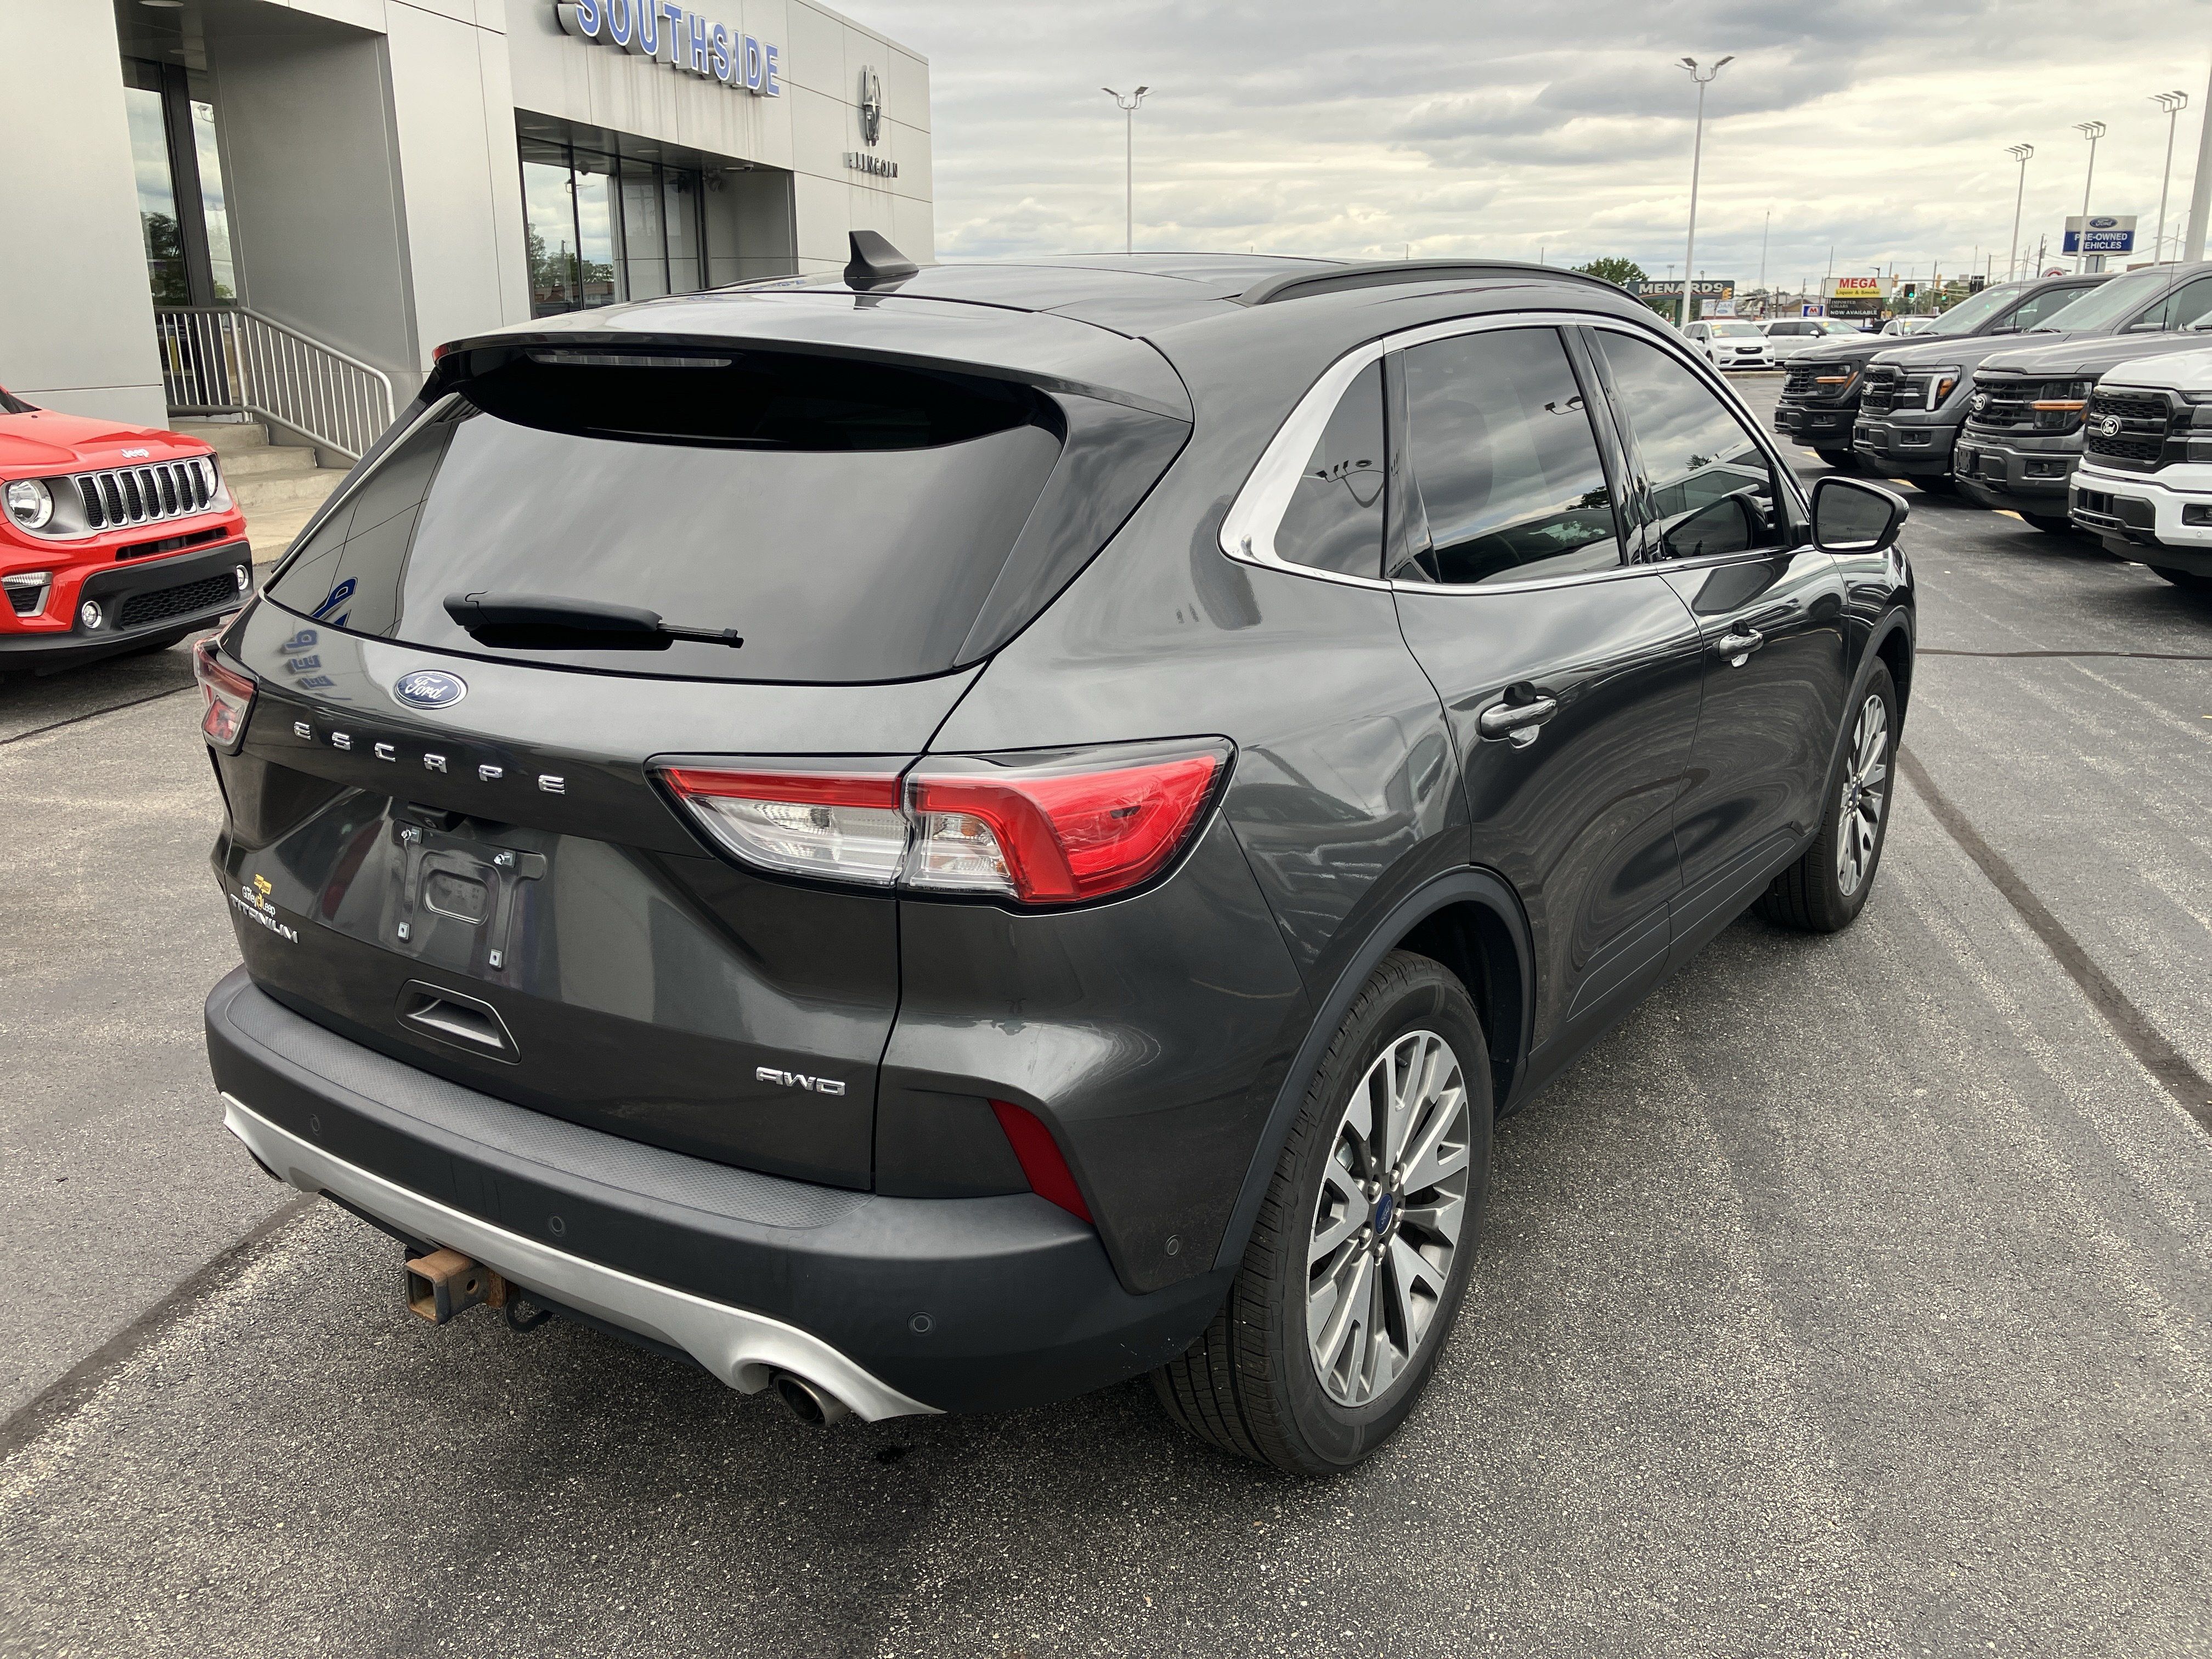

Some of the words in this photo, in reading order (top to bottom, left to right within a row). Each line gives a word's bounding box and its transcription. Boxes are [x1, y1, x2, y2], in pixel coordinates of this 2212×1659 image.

[855, 151, 898, 178] LINCOLN
[1639, 283, 1724, 294] MENARDS
[1839, 279, 1877, 289] MEGA
[120, 448, 149, 459] Jeep
[405, 676, 449, 699] Ford
[294, 721, 566, 795] ESCAPE
[230, 893, 298, 944] TITANIUM
[755, 1066, 846, 1096] AWD
